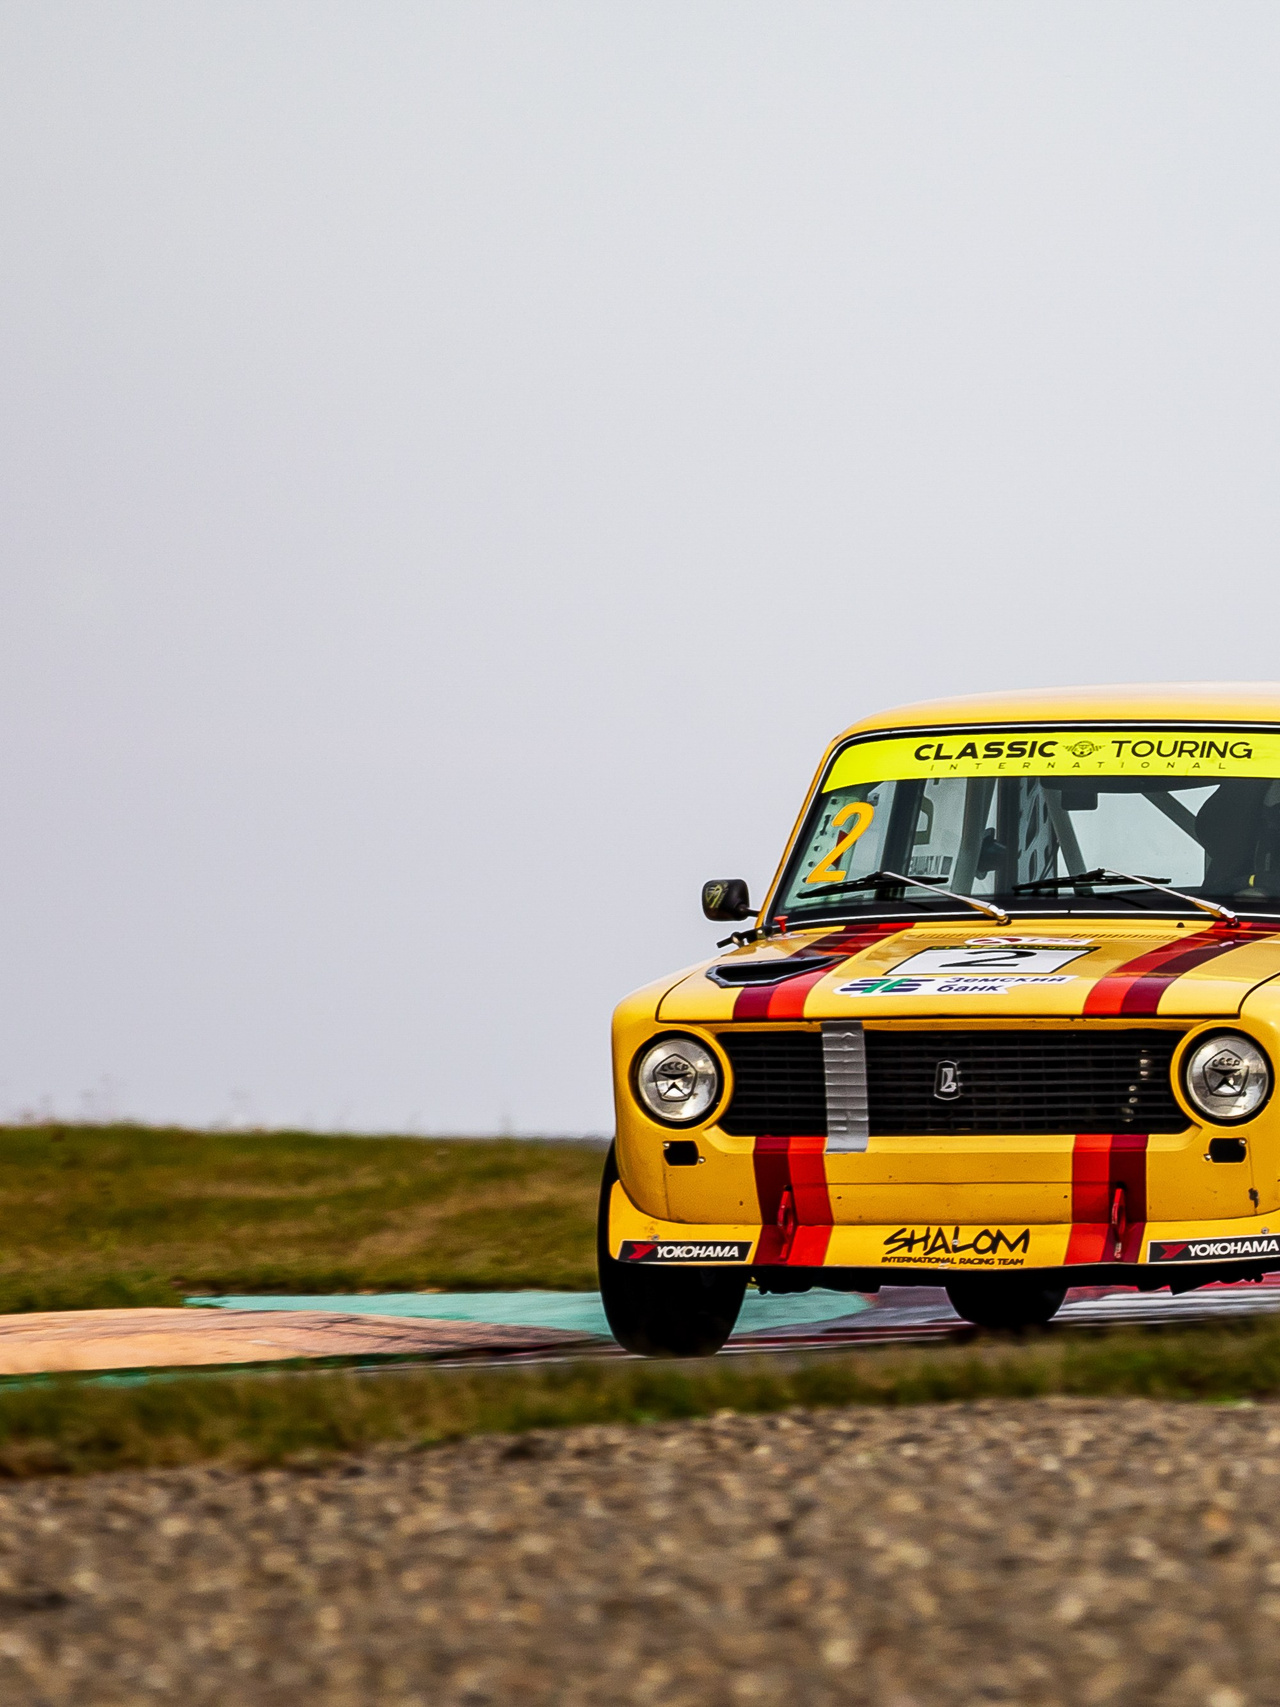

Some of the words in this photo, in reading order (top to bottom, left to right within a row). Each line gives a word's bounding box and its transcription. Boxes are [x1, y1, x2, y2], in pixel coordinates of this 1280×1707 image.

[914, 740, 1058, 761] CLASSIC
[1111, 740, 1253, 759] TOURING
[930, 761, 1227, 772] INTERNATIONAL
[805, 801, 875, 884] 2
[938, 949, 1038, 968] 2
[943, 976, 1066, 984] Земский
[936, 983, 1002, 993] банк
[1212, 1057, 1240, 1067] СССР
[883, 1226, 1030, 1256] SHALOM
[656, 1245, 740, 1258] YOKOHAMA
[1188, 1239, 1280, 1257] YOKOHAMA
[881, 1256, 957, 1265] INTERNATIONAL
[959, 1257, 995, 1266] RACING
[997, 1257, 1025, 1266] TEAM
